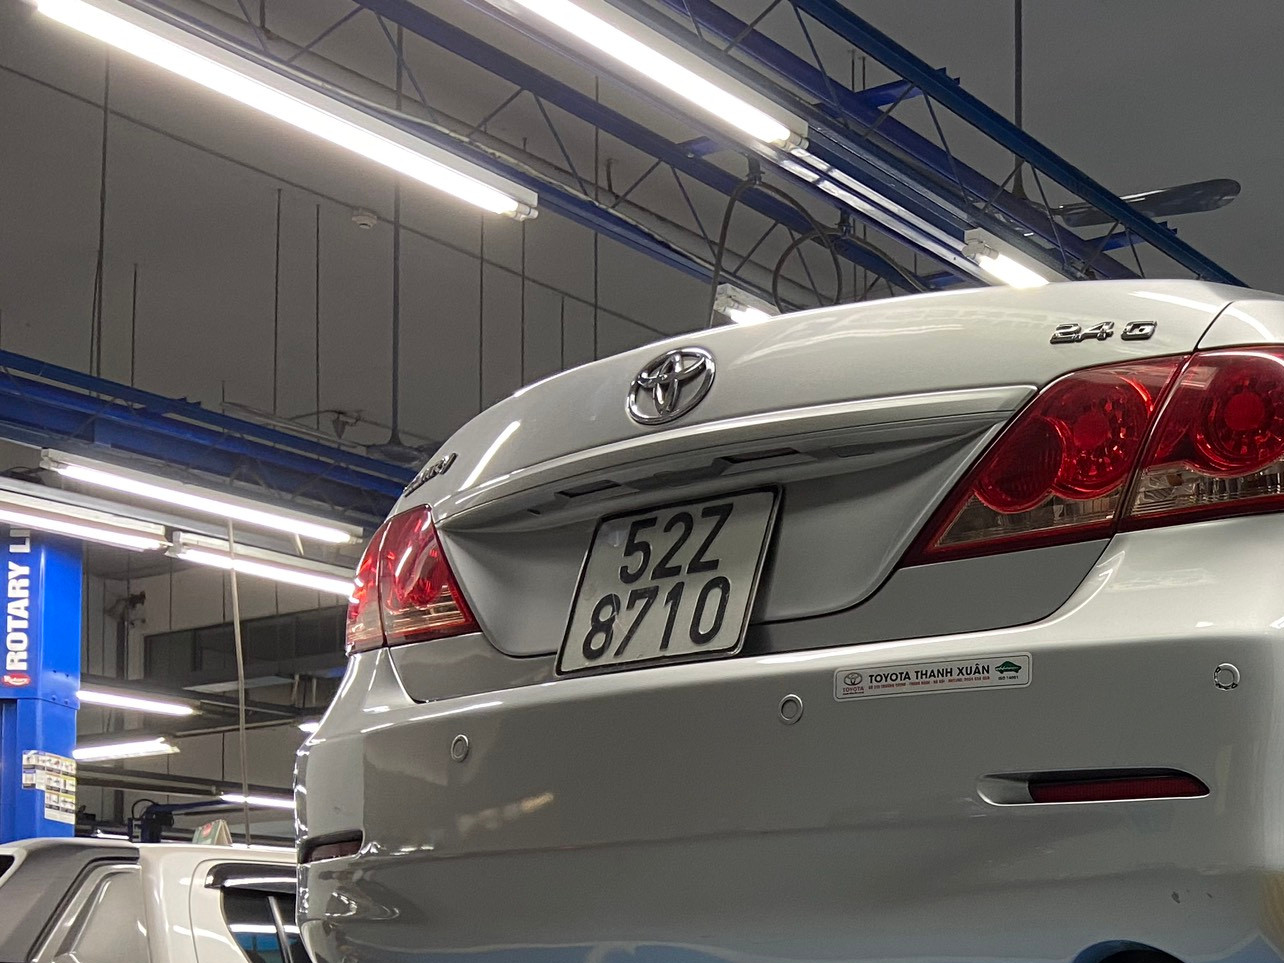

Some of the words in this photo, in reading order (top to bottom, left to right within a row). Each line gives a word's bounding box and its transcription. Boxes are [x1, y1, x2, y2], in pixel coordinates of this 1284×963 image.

[9, 525, 31, 553] LI
[619, 502, 734, 584] 52Z
[6, 560, 30, 671] ROTARY
[582, 575, 731, 661] 8710
[869, 671, 911, 684] TOYOTA
[915, 667, 953, 680] THANH
[957, 663, 990, 676] XUÂN
